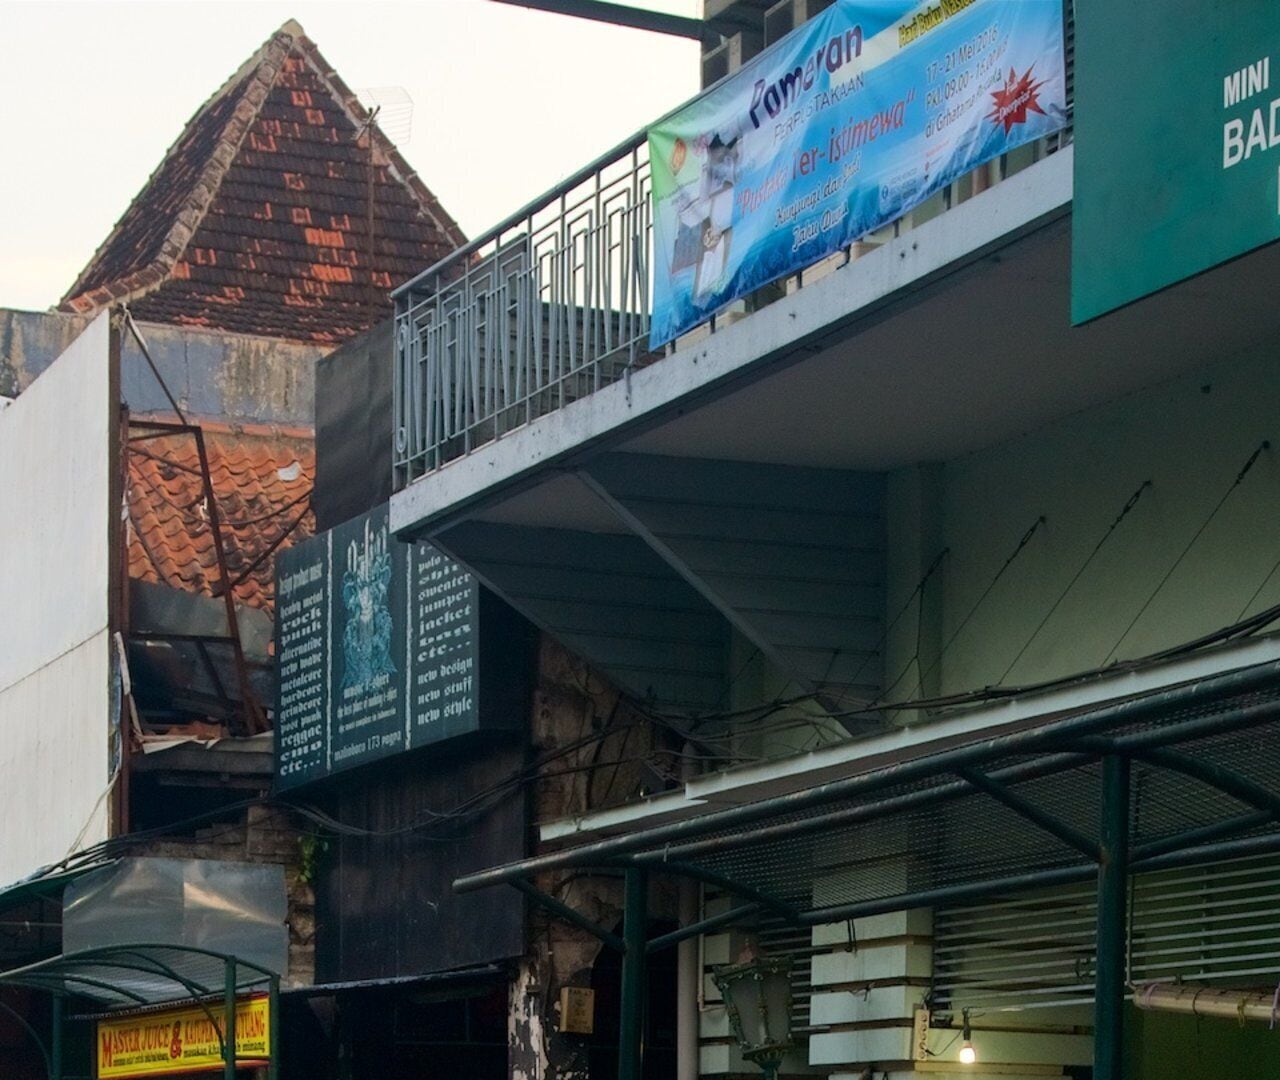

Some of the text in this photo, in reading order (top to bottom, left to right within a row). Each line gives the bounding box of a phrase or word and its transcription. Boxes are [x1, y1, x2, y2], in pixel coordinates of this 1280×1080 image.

[749, 25, 863, 129] Pameran
[1223, 57, 1270, 109] MINI
[418, 573, 471, 601] sweater
[420, 588, 471, 619] jumper
[281, 608, 322, 632] rock
[281, 621, 322, 647] punk
[420, 604, 471, 636] jacket
[418, 657, 473, 685] new design
[418, 676, 472, 705] new stuff
[418, 696, 472, 725] new style
[281, 724, 322, 747] reggae
[101, 1026, 141, 1068] MASTER
[142, 1024, 170, 1049] JUICE
[170, 1020, 183, 1060] &
